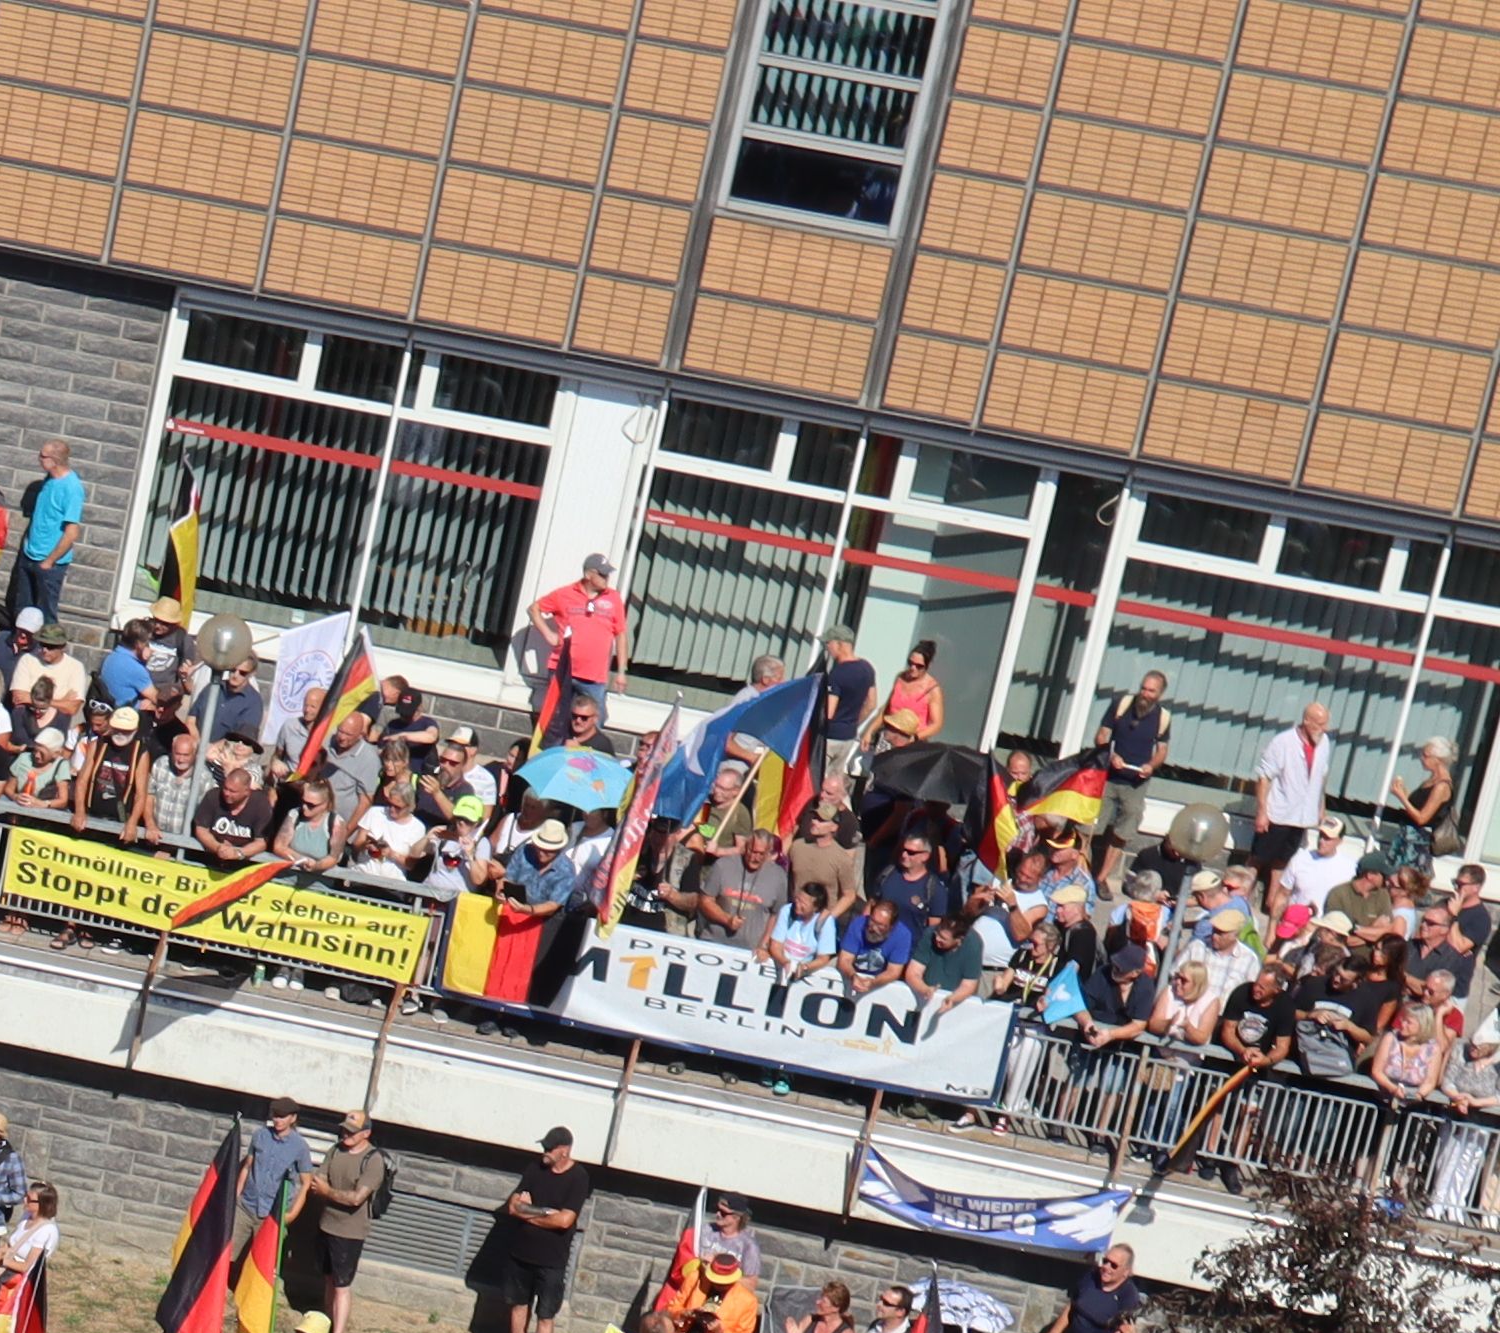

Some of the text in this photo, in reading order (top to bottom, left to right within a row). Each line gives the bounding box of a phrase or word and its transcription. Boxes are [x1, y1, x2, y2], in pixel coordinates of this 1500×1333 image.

[19, 838, 416, 943] Schmöllner Büer stehen auf:
[15, 861, 411, 971] Stoppt de Wahnsinn!
[642, 995, 805, 1039] BERLIN
[932, 1201, 1037, 1236] KRIEG
[934, 1192, 1037, 1214] NIE WIEDER
